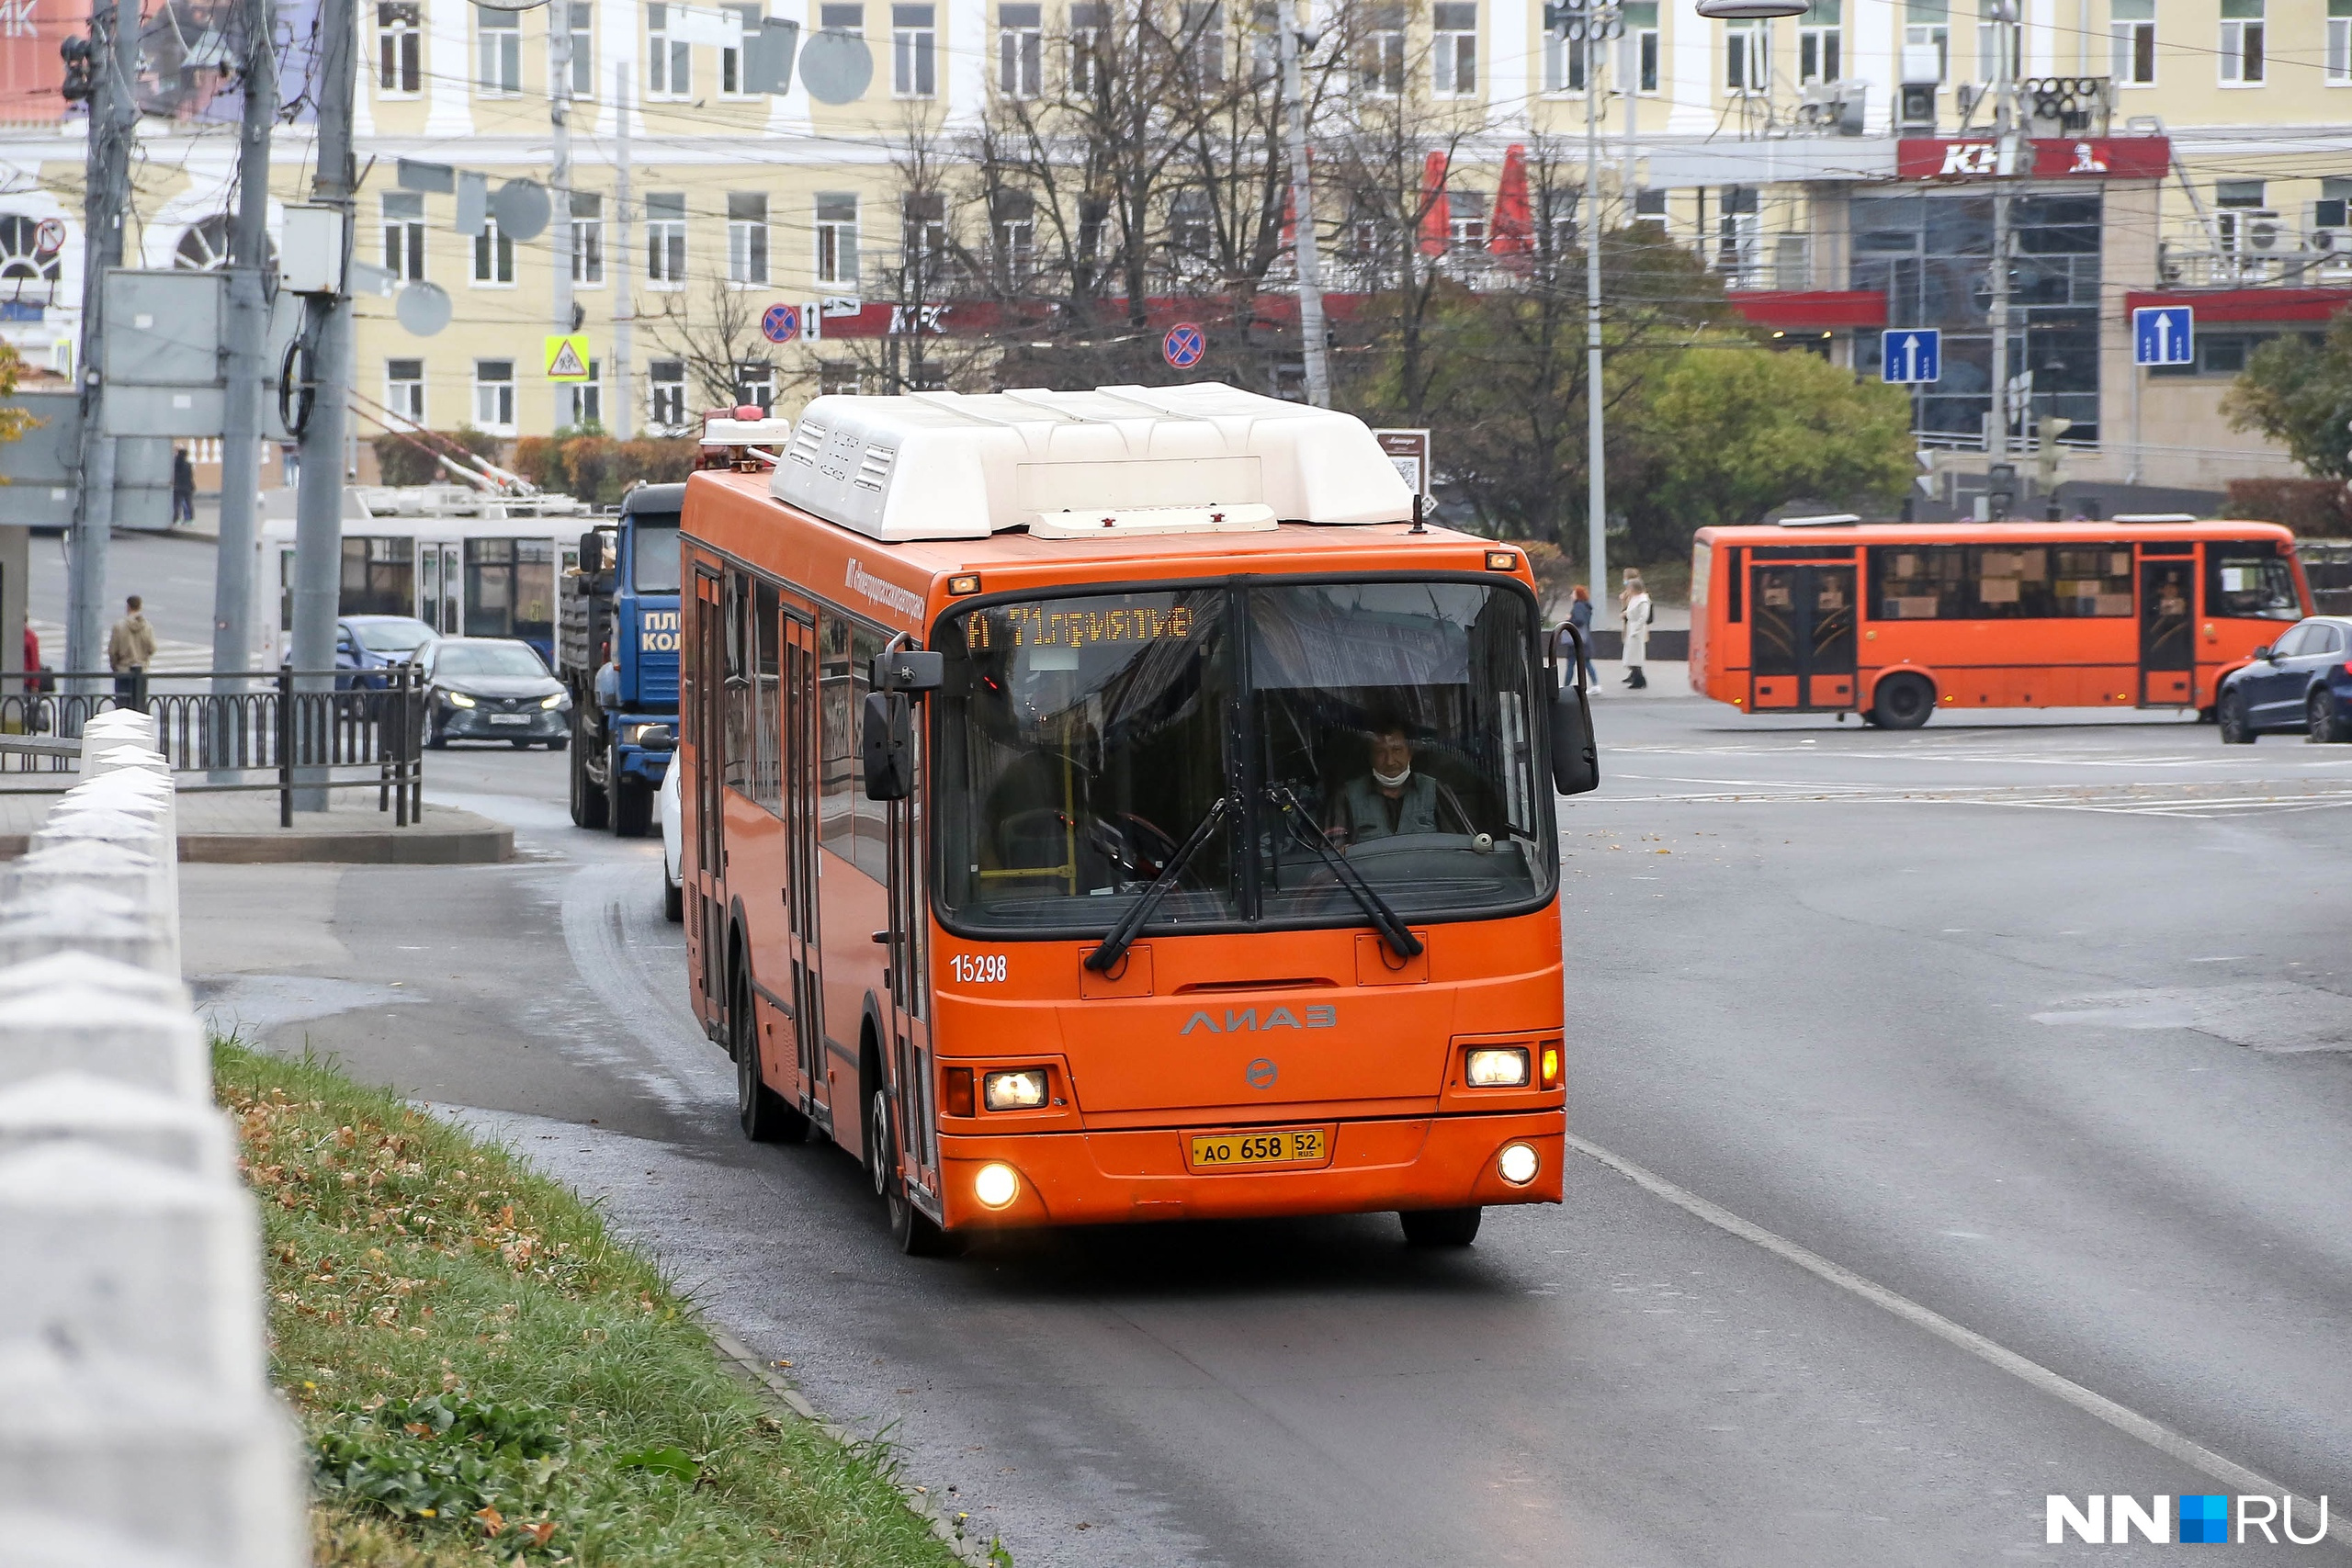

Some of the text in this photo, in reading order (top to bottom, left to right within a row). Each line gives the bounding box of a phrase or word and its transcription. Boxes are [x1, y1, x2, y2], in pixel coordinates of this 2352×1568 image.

[1939, 144, 1997, 175] KF
[888, 305, 953, 333] KFC
[645, 613, 681, 630] ПЛ
[950, 954, 1007, 982] 15298
[1180, 1004, 1337, 1035] ЛИАЗ
[1240, 1137, 1282, 1159] 658
[1295, 1134, 1317, 1150] 52
